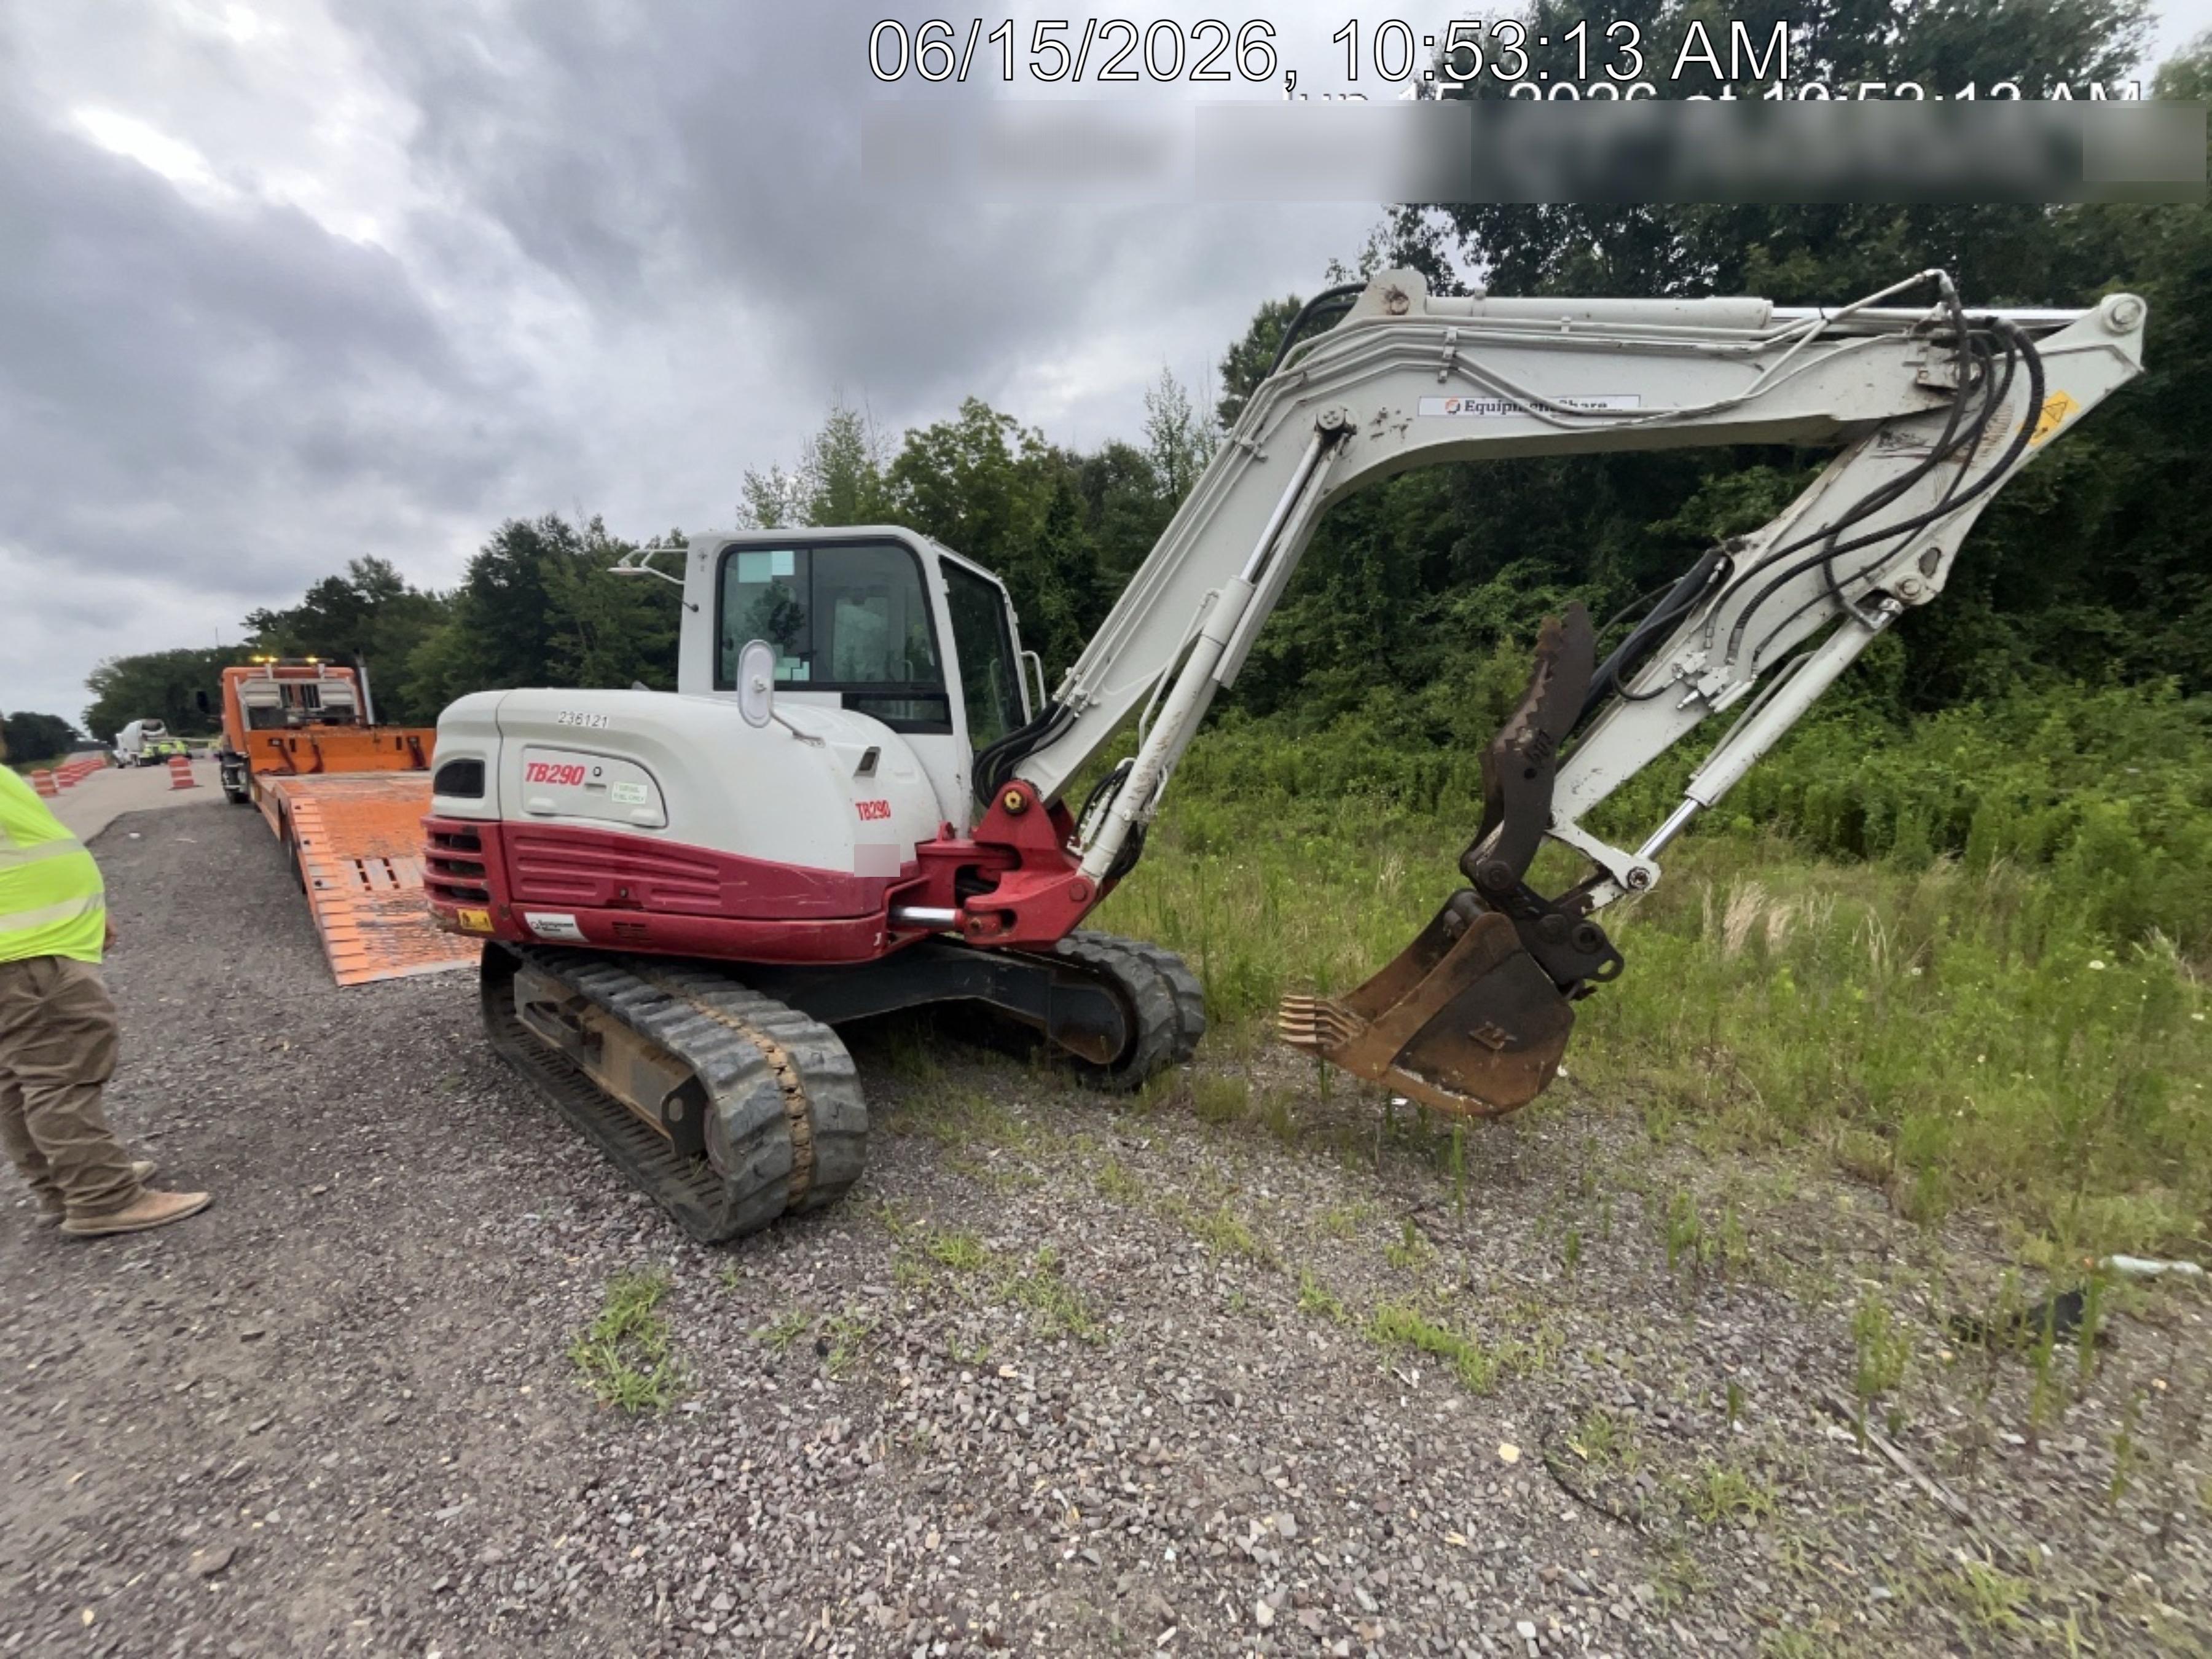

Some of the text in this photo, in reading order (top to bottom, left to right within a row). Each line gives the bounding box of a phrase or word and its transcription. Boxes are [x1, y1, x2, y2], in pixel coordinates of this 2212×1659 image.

[558, 711, 607, 728] 236121
[525, 763, 585, 786] TB290
[855, 800, 891, 821] TB290
